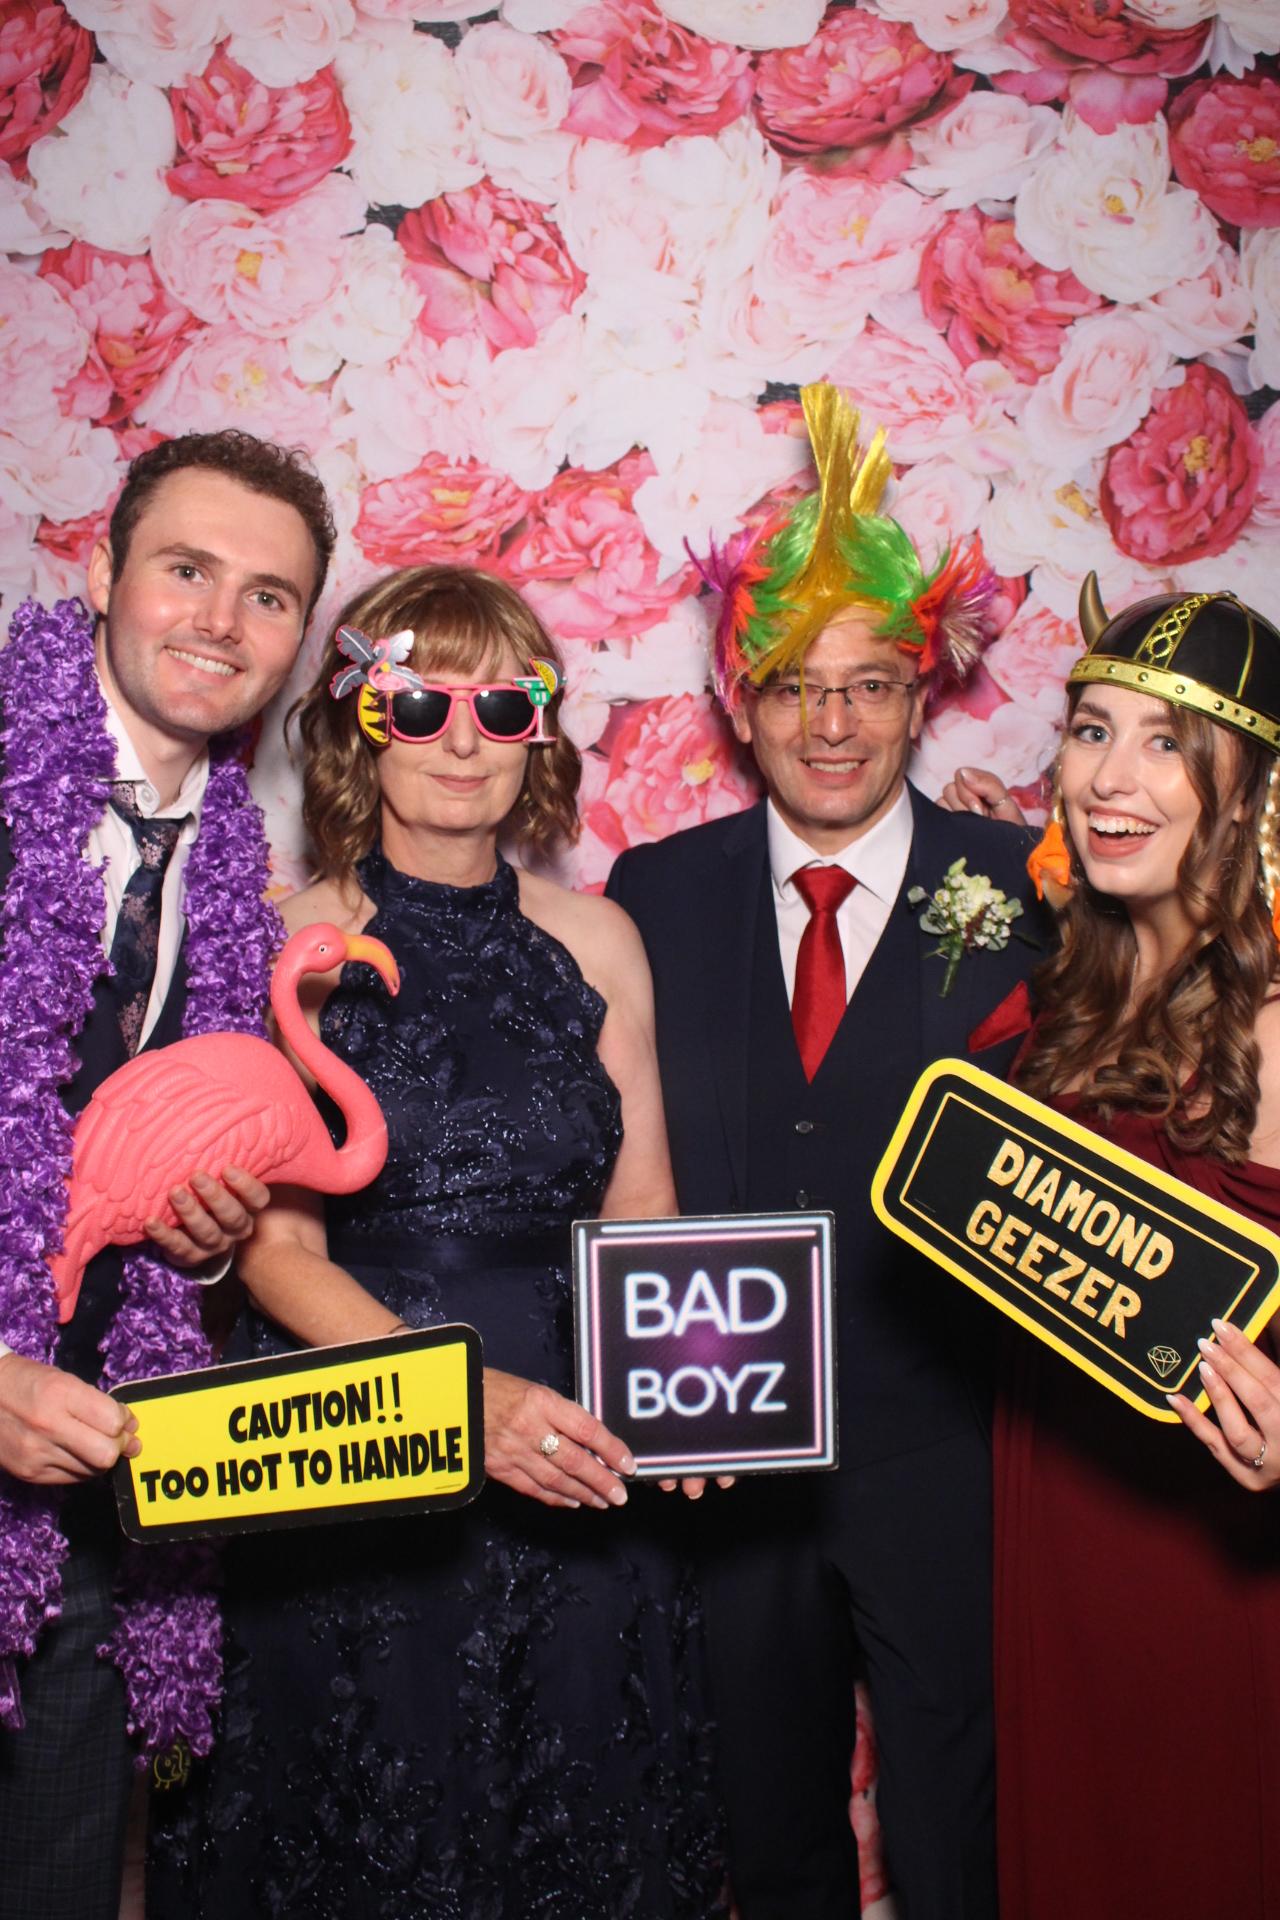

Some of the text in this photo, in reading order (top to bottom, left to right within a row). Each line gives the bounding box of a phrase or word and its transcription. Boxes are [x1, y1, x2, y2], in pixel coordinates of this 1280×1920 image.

[986, 1138, 1174, 1280] DIAMOND
[625, 1268, 787, 1338] BAD
[965, 1200, 1142, 1339] GEEZER
[228, 1372, 404, 1443] CAUTION!!
[628, 1362, 787, 1419] BOYZ
[140, 1426, 463, 1503] TOO HOT TO HANDLE
